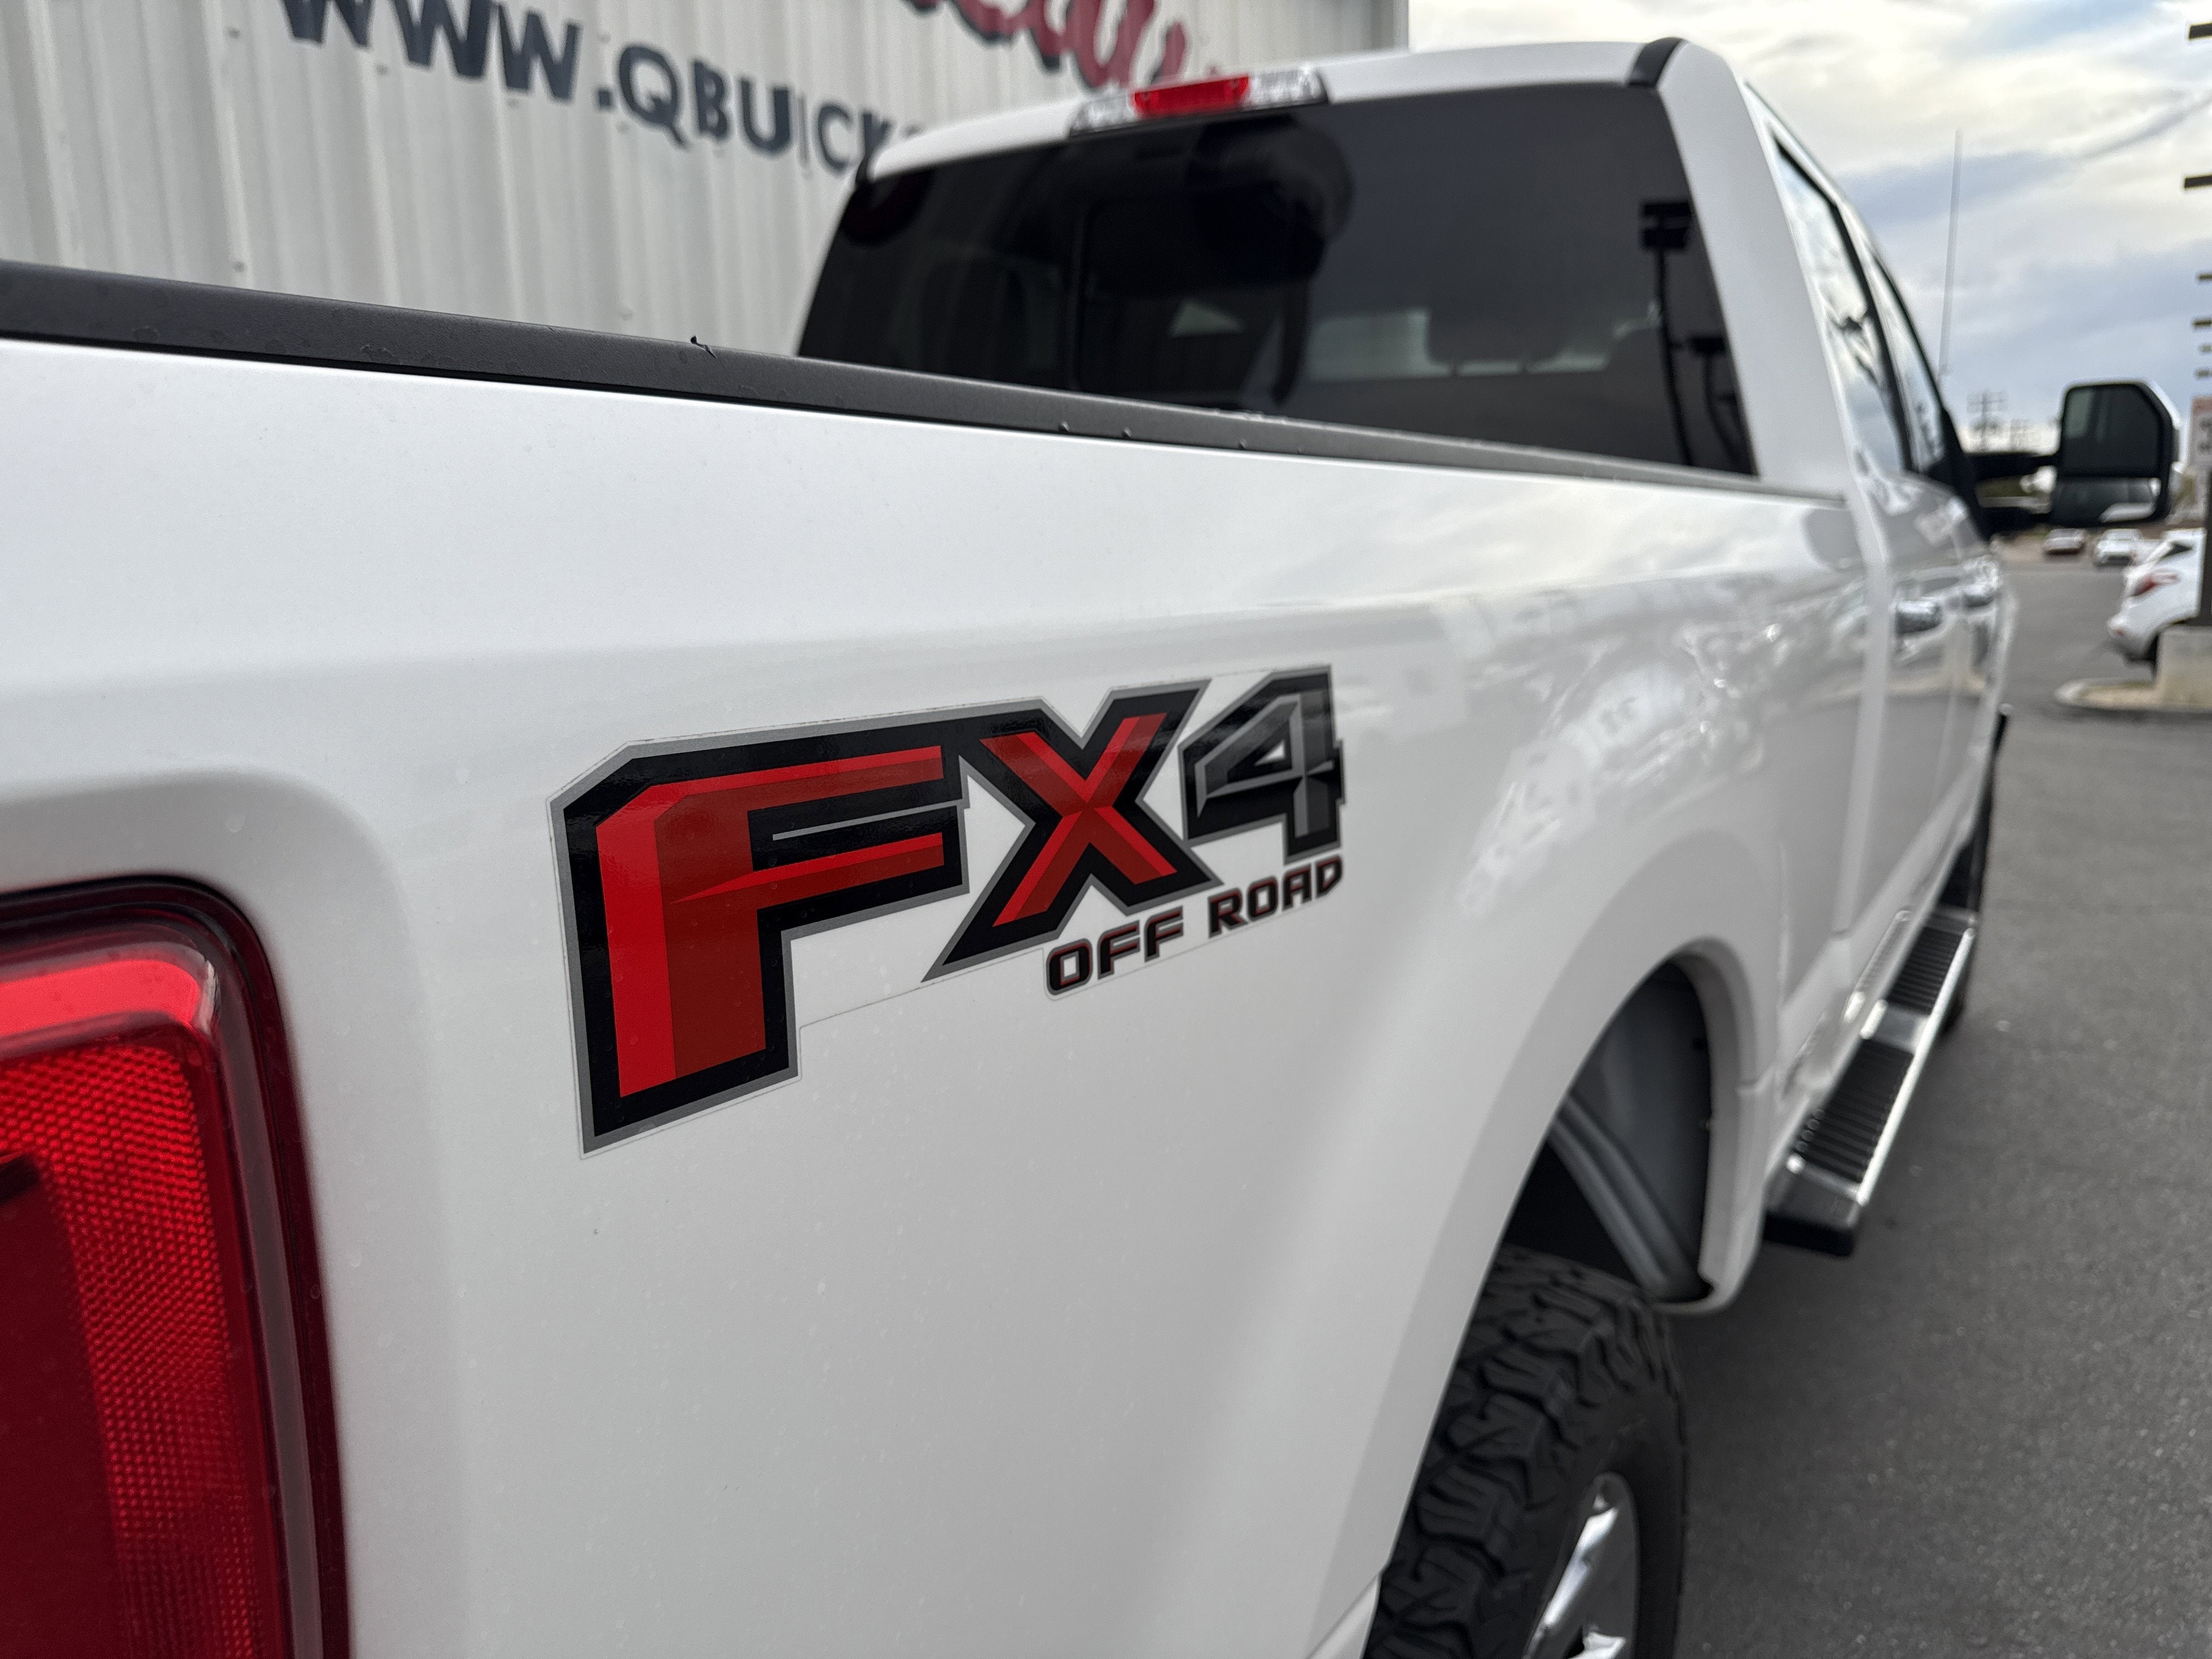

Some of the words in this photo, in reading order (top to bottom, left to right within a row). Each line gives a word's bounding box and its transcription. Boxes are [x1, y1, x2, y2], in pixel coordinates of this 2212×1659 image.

[549, 665, 1345, 1155] FX4
[1046, 905, 1184, 996] OFF
[1207, 854, 1343, 938] ROAD
